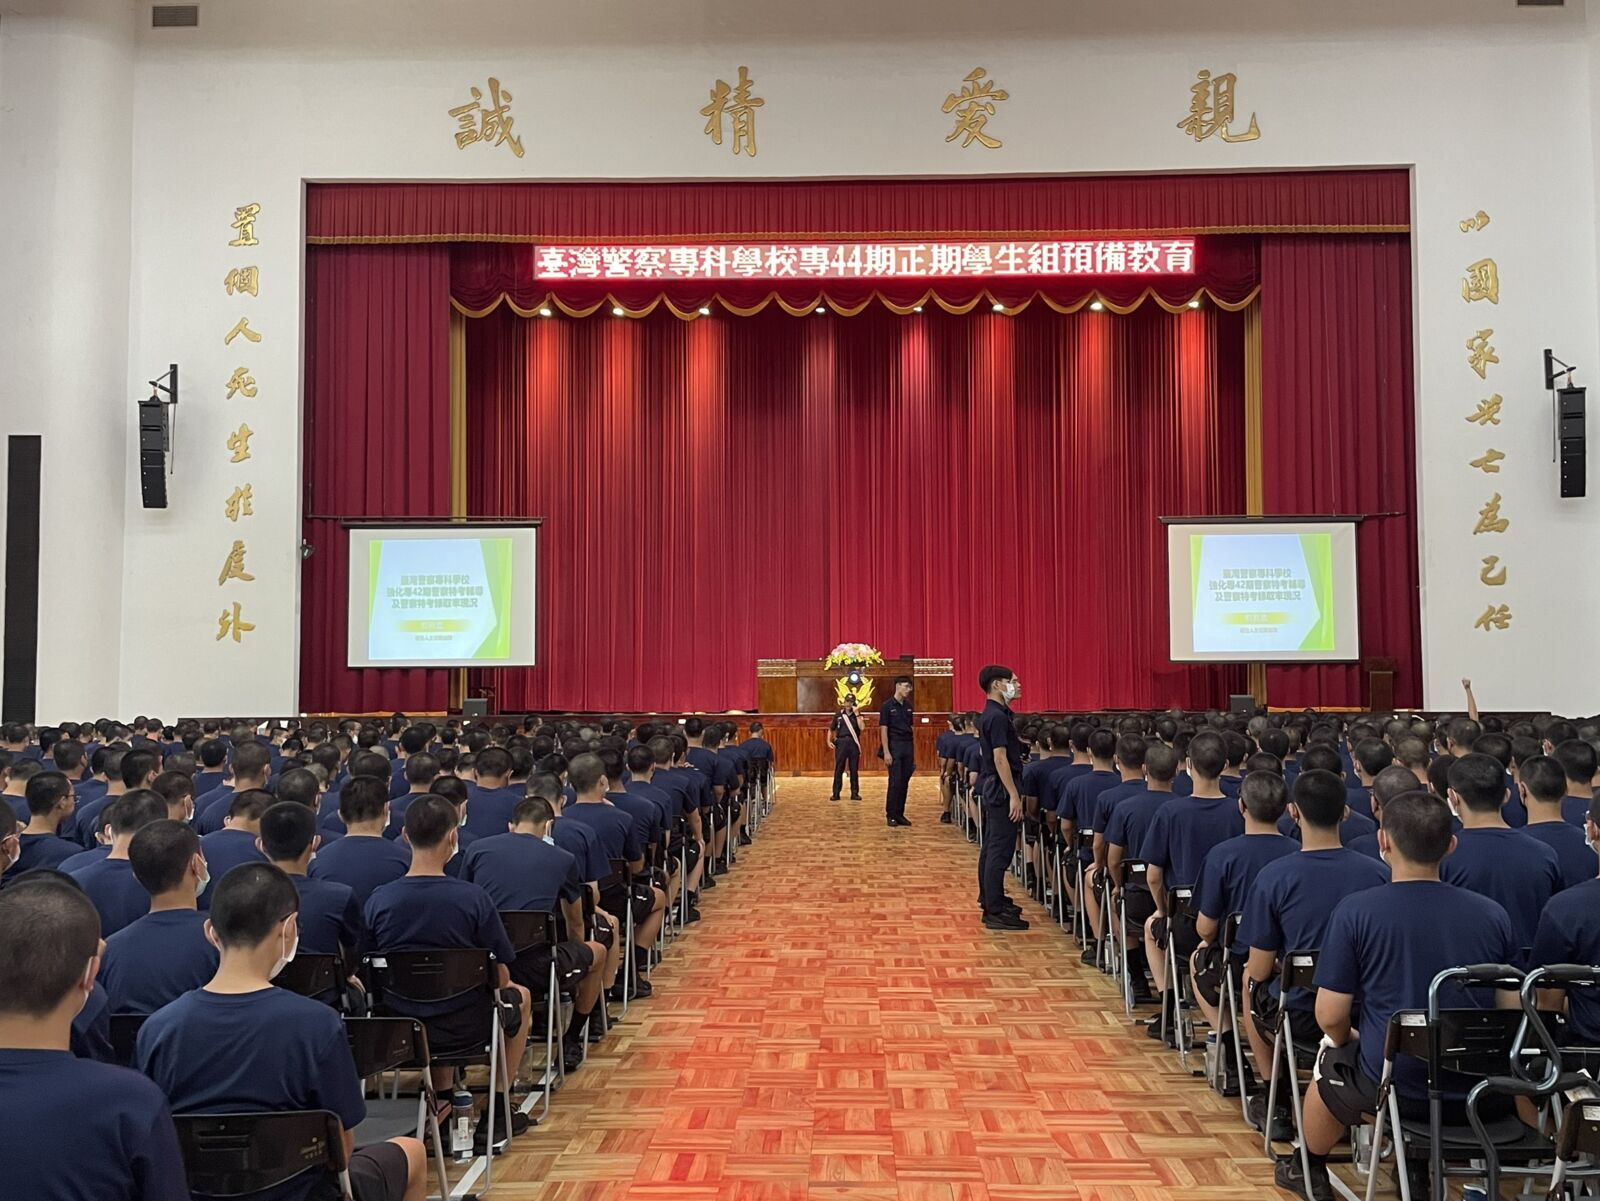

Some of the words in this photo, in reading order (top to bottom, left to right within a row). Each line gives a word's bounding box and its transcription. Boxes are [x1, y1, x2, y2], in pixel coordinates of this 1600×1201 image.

[535, 240, 1196, 281] 臺灣警察專科學校專44期正期學生組預備教育
